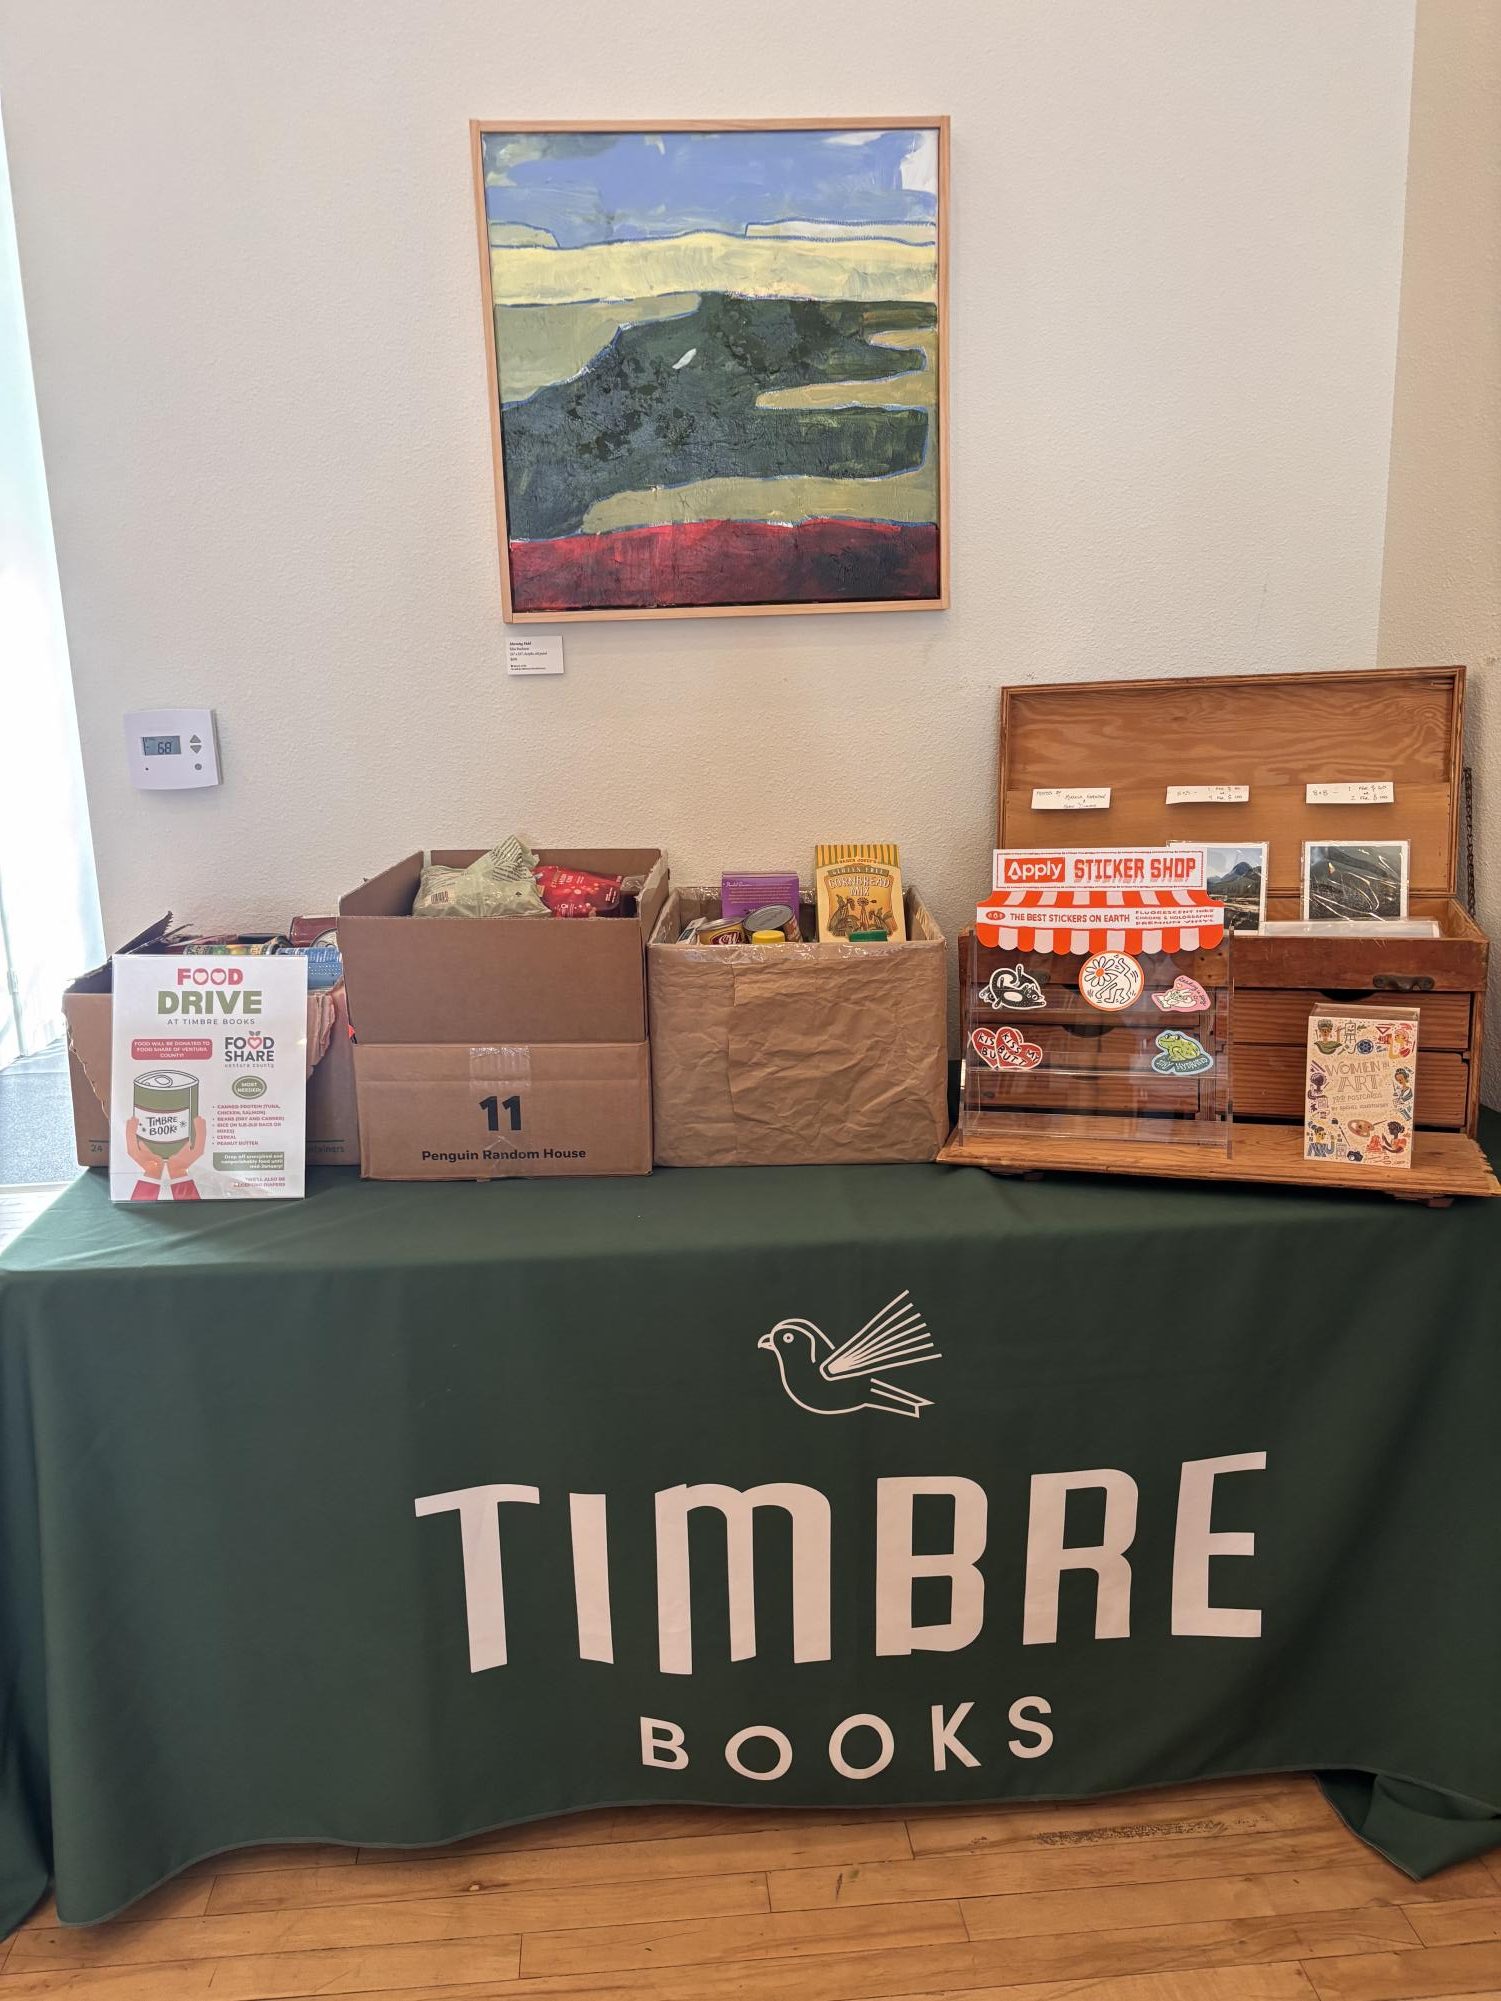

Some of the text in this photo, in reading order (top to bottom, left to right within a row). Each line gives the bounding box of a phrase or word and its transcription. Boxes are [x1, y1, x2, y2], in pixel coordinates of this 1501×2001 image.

[157, 742, 172, 754] 68
[1007, 857, 1196, 881] Apply STICKER SHOP
[828, 876, 891, 888] CORNBREAD
[850, 886, 870, 896] MIX
[1010, 912, 1026, 920] THE
[1026, 913, 1047, 922] BEST
[1048, 914, 1087, 923] STICKERS
[1088, 914, 1101, 922] ON
[1104, 914, 1130, 922] EARTH
[177, 968, 244, 986] FOOD
[158, 990, 262, 1014] DRIVE
[979, 1034, 995, 1046] KIS
[1002, 1033, 1039, 1062] KISS MY
[224, 1050, 274, 1062] SHARE
[998, 1045, 1026, 1066] BUTT
[1324, 1061, 1380, 1076] WOMEN
[1338, 1074, 1378, 1094] ART
[479, 1095, 522, 1131] 11
[146, 1116, 178, 1127] TIMBRE
[150, 1125, 178, 1136] BOOKS
[422, 1148, 587, 1163] Penguin Random House
[414, 1451, 1267, 1674] TIMBRE
[640, 1696, 1055, 1781] BOOKS
